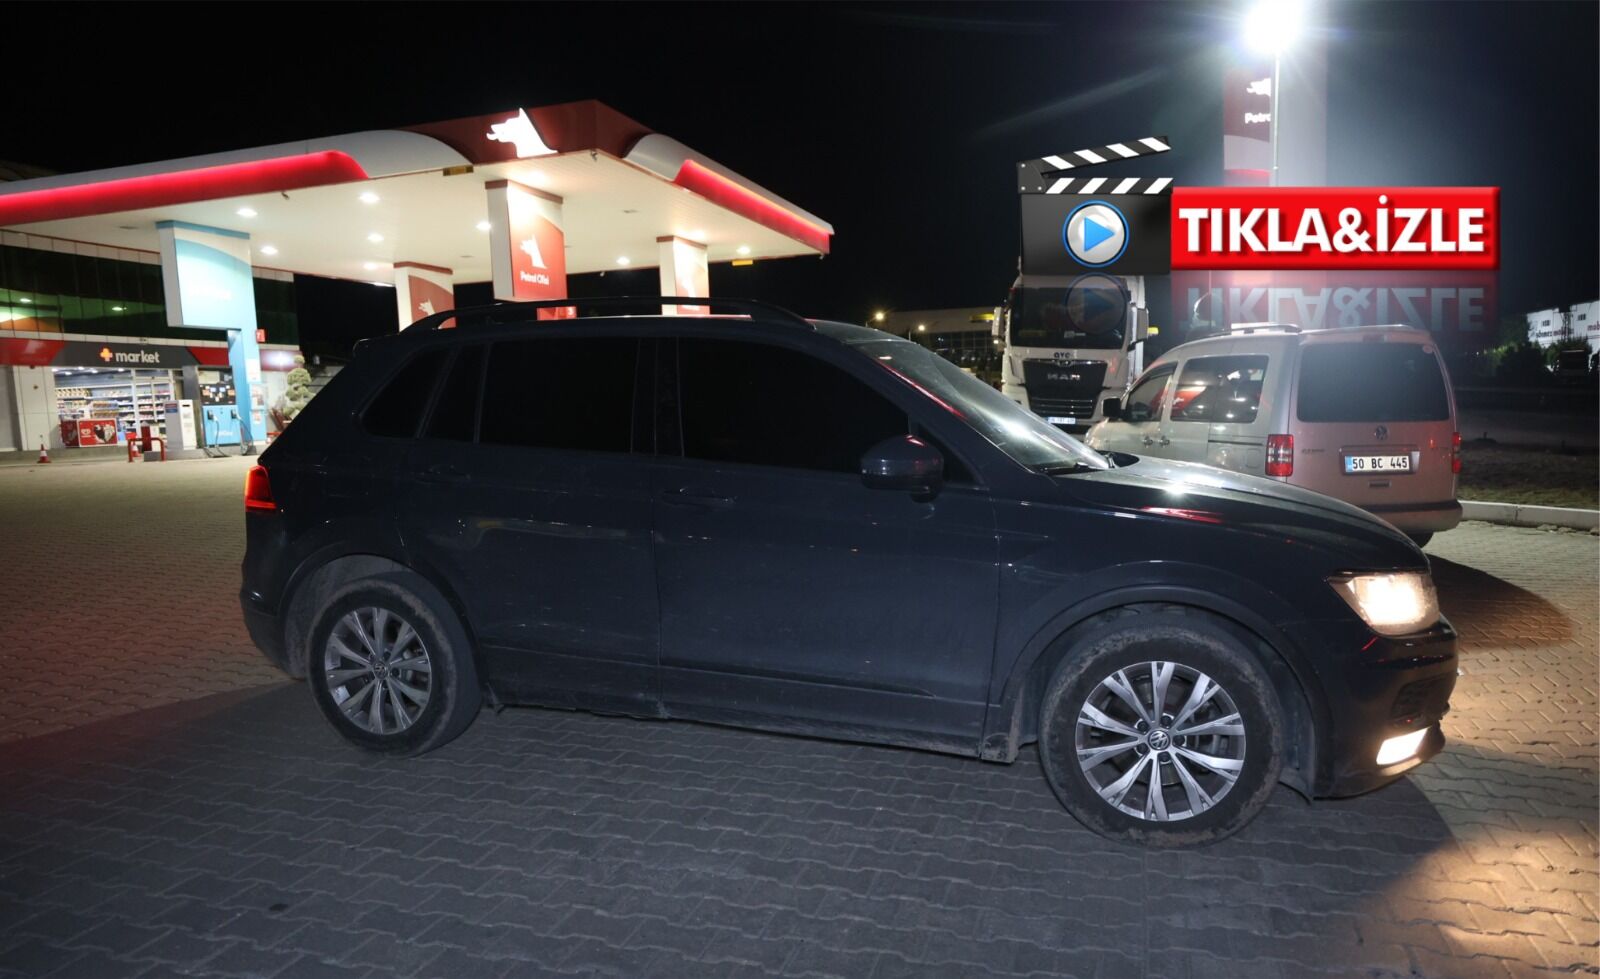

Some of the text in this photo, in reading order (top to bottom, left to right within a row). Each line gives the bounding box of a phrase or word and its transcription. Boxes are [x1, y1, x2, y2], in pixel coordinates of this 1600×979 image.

[115, 350, 160, 363] market
[1353, 457, 1407, 470] 50 BC 445
